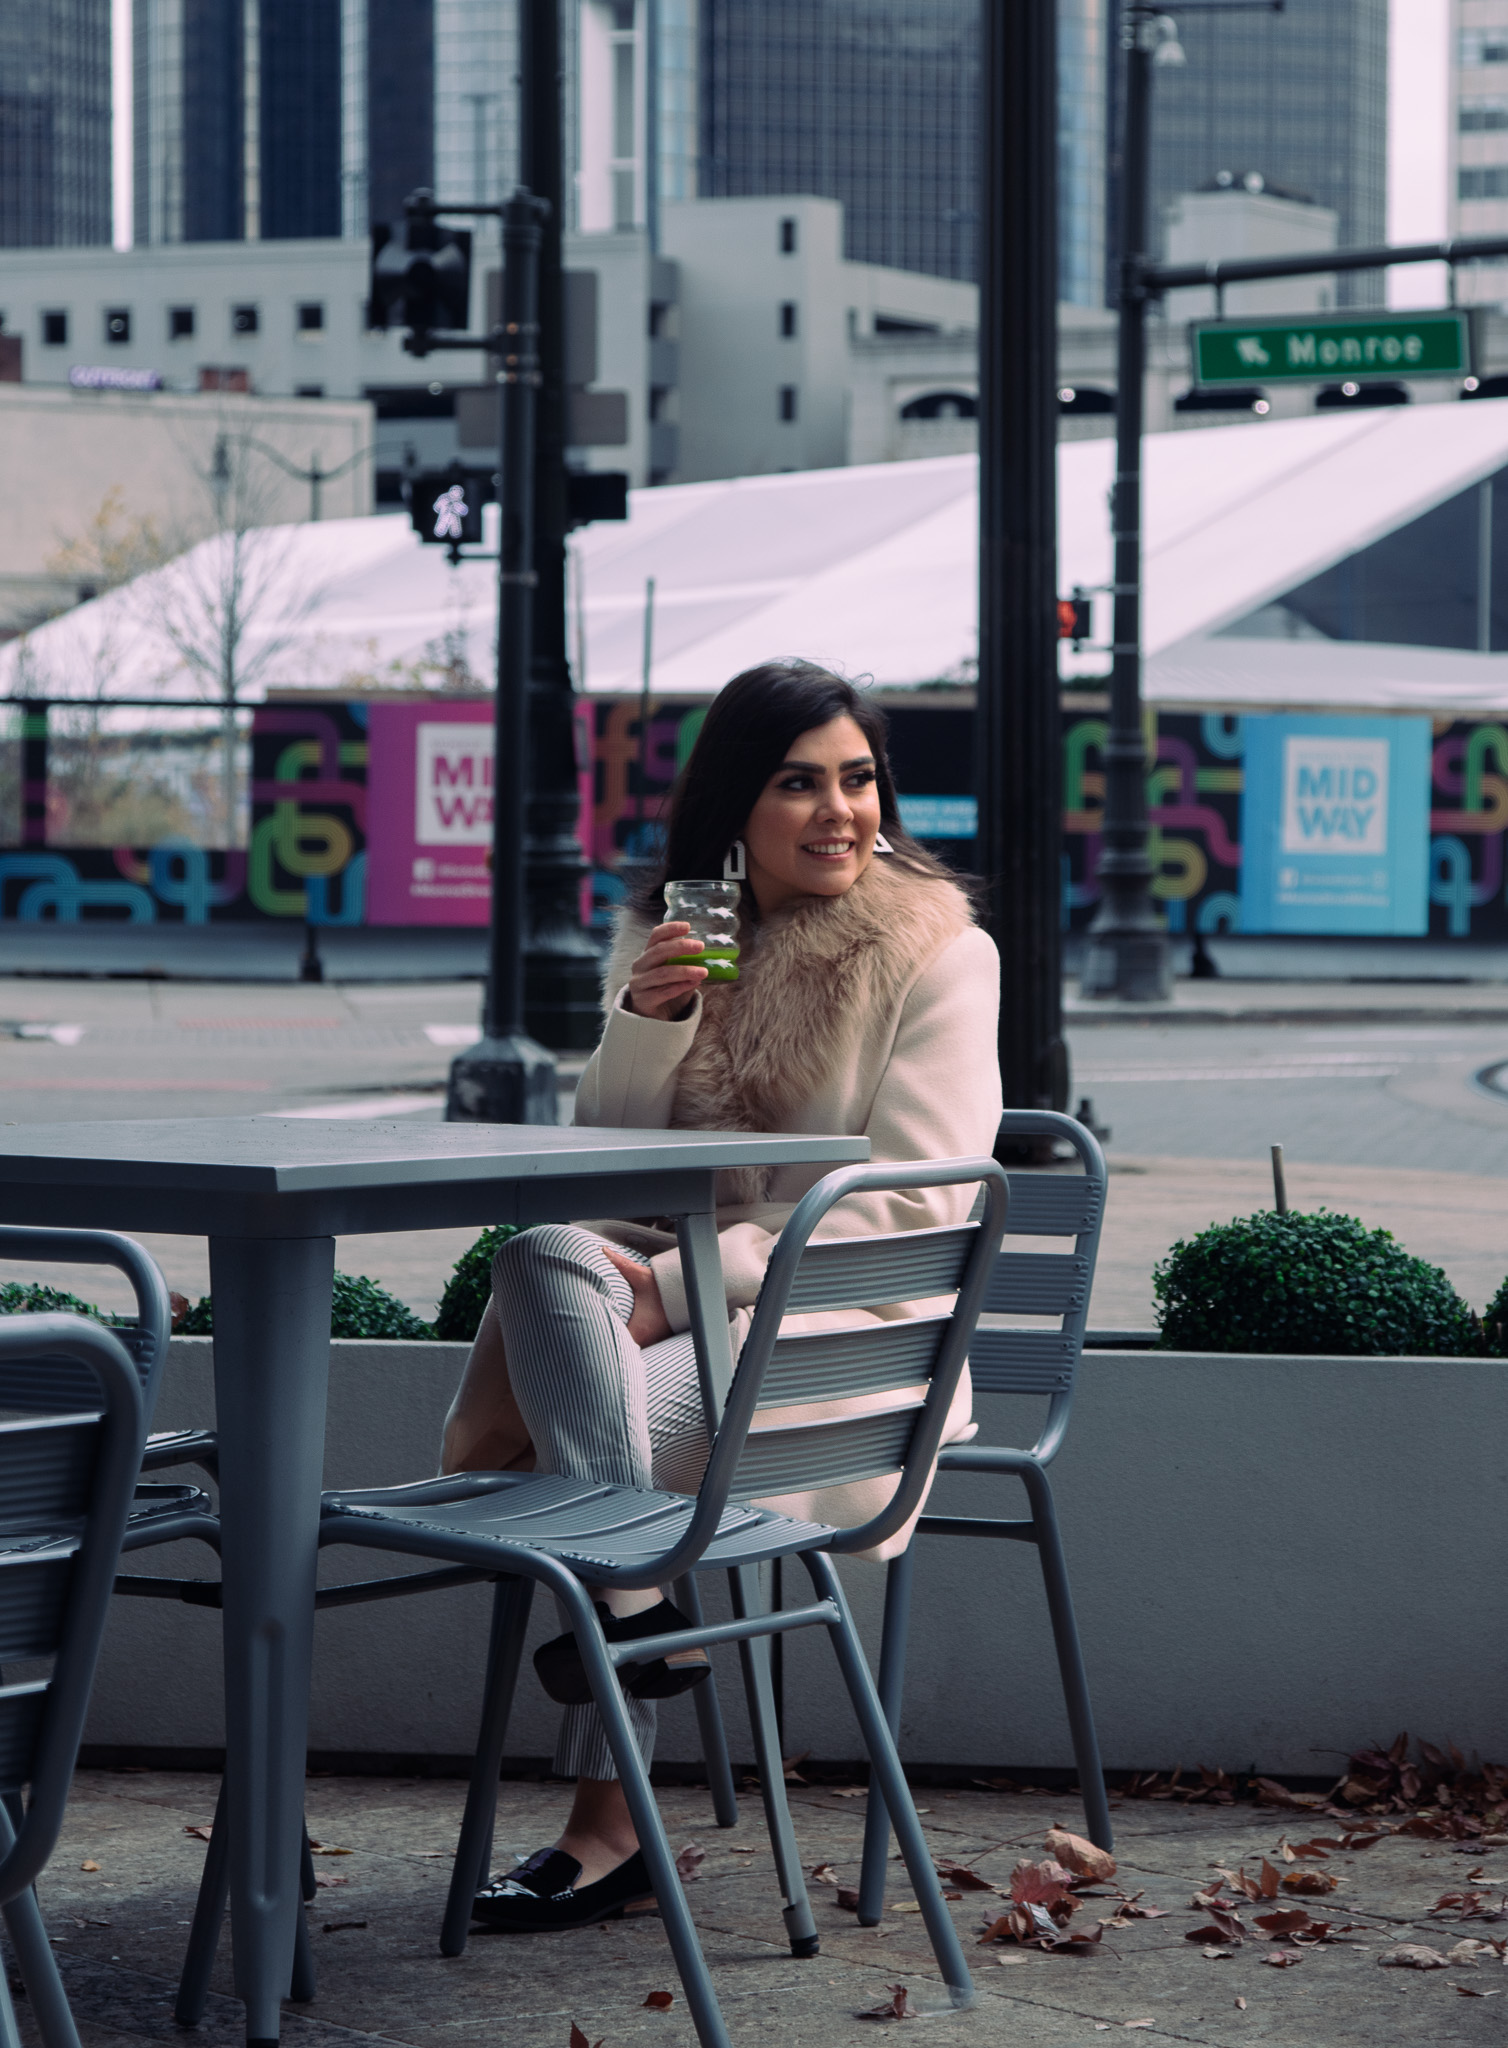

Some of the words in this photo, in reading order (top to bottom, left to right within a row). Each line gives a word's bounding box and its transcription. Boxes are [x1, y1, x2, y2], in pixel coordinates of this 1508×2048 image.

[1288, 333, 1422, 365] Monroe
[435, 756, 494, 786] MI
[1298, 767, 1377, 799] MID
[1298, 806, 1375, 839] WAY
